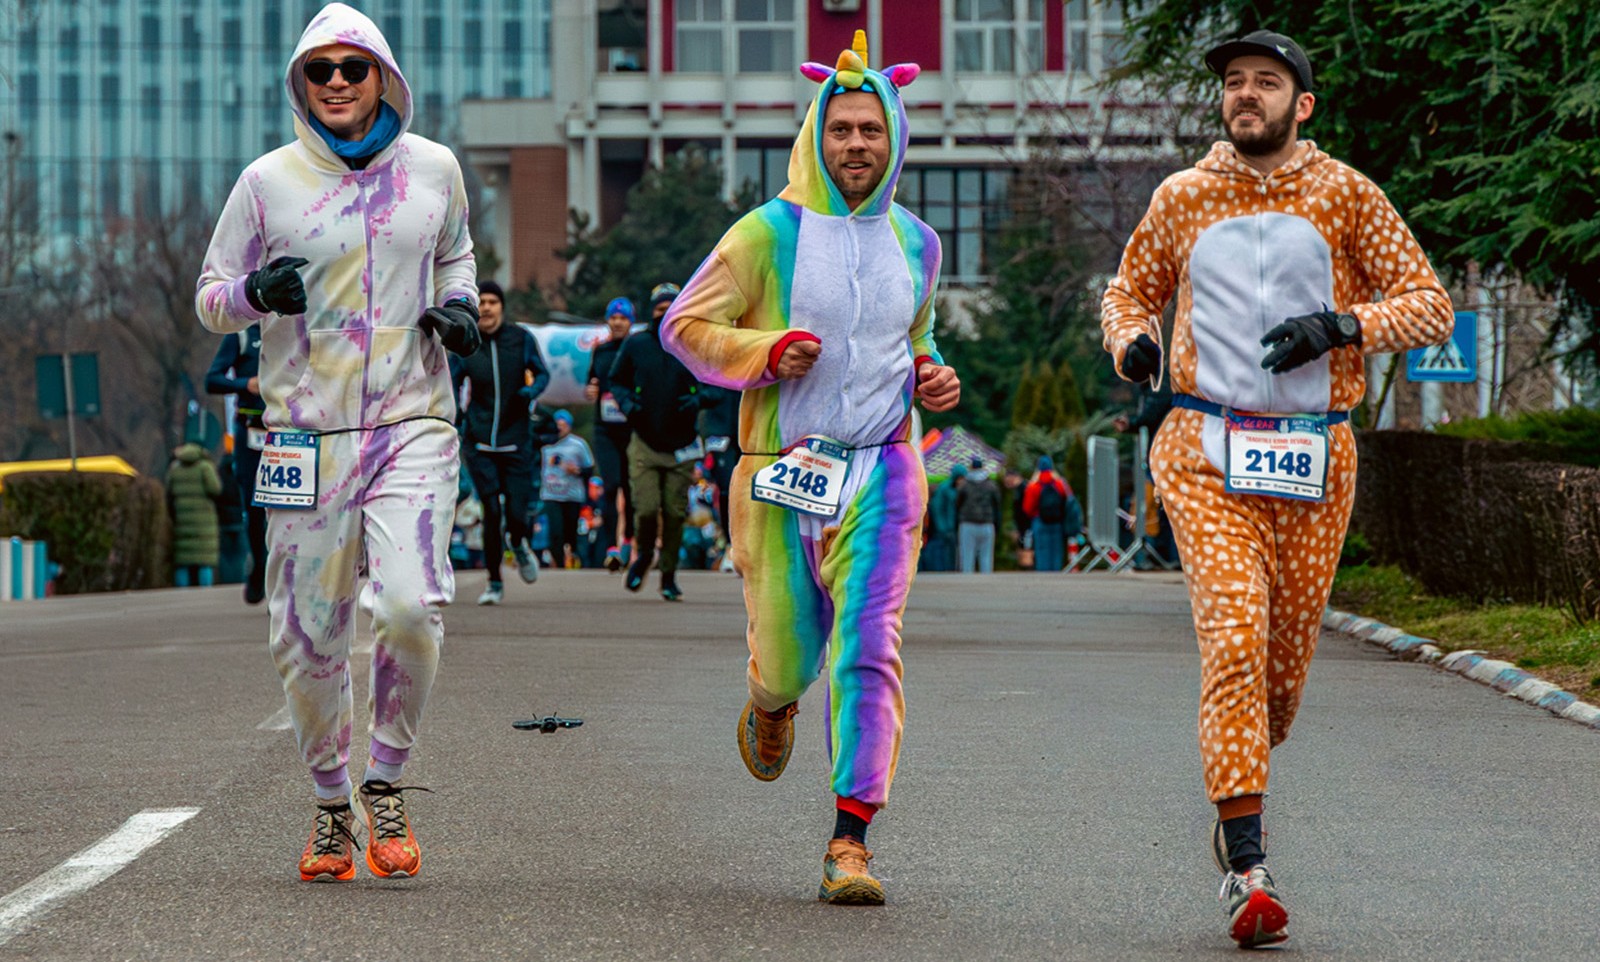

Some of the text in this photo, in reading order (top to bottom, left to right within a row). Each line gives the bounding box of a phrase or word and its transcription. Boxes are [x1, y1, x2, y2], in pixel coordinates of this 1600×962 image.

[260, 464, 302, 489] 2148
[1245, 449, 1312, 478] 2148
[769, 462, 828, 497] 2148
